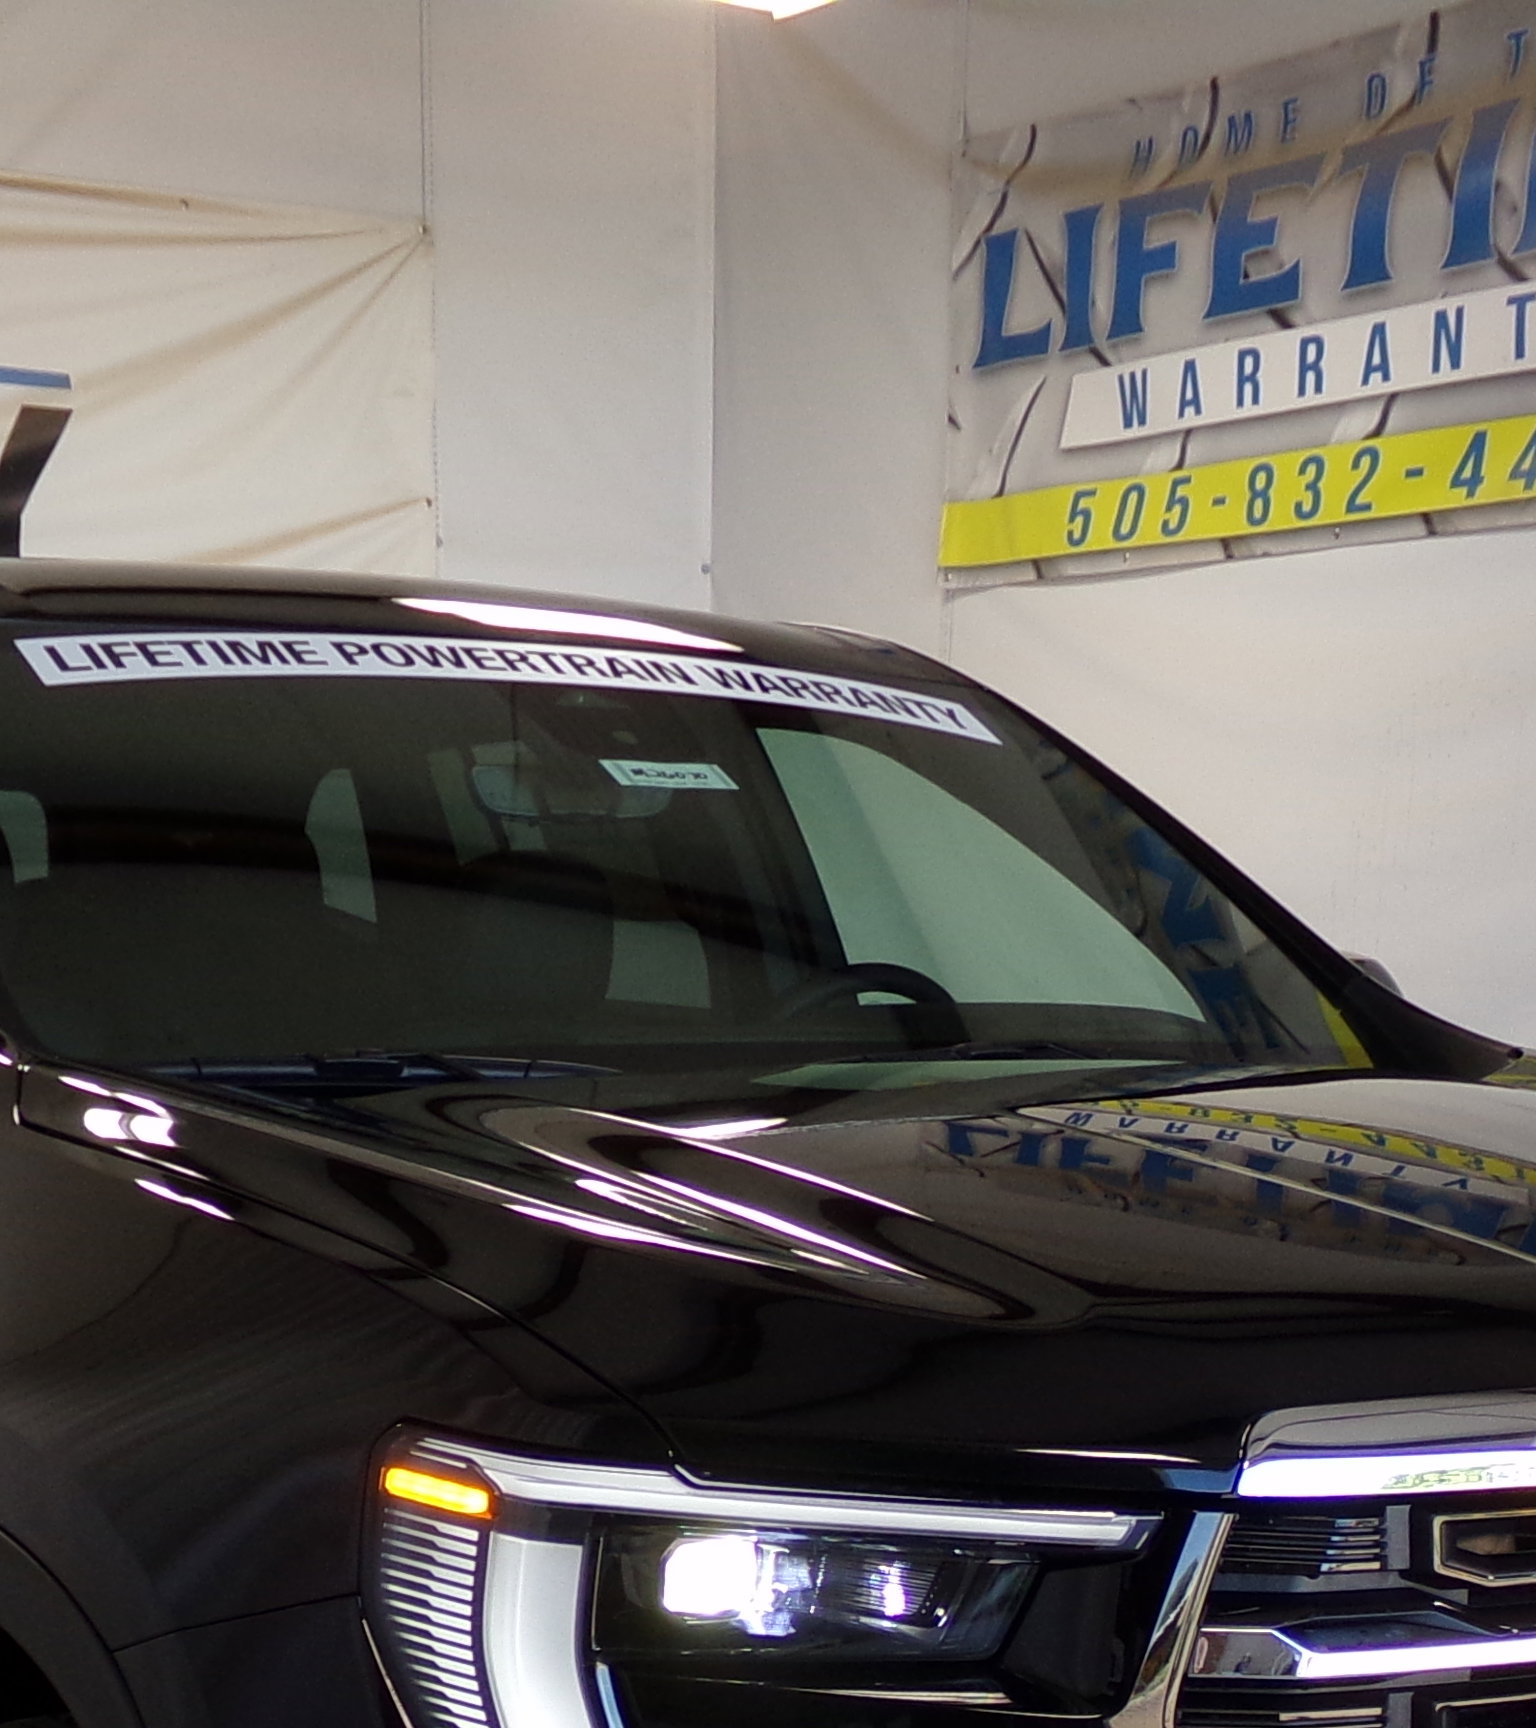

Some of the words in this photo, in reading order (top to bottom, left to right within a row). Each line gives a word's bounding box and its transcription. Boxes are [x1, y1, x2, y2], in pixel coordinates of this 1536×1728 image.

[1128, 97, 1299, 178] HOME
[1364, 53, 1438, 121] OF
[43, 640, 329, 673] LIFETIME
[328, 641, 699, 686] POWERTRAIN
[696, 665, 968, 730] WARRANTY
